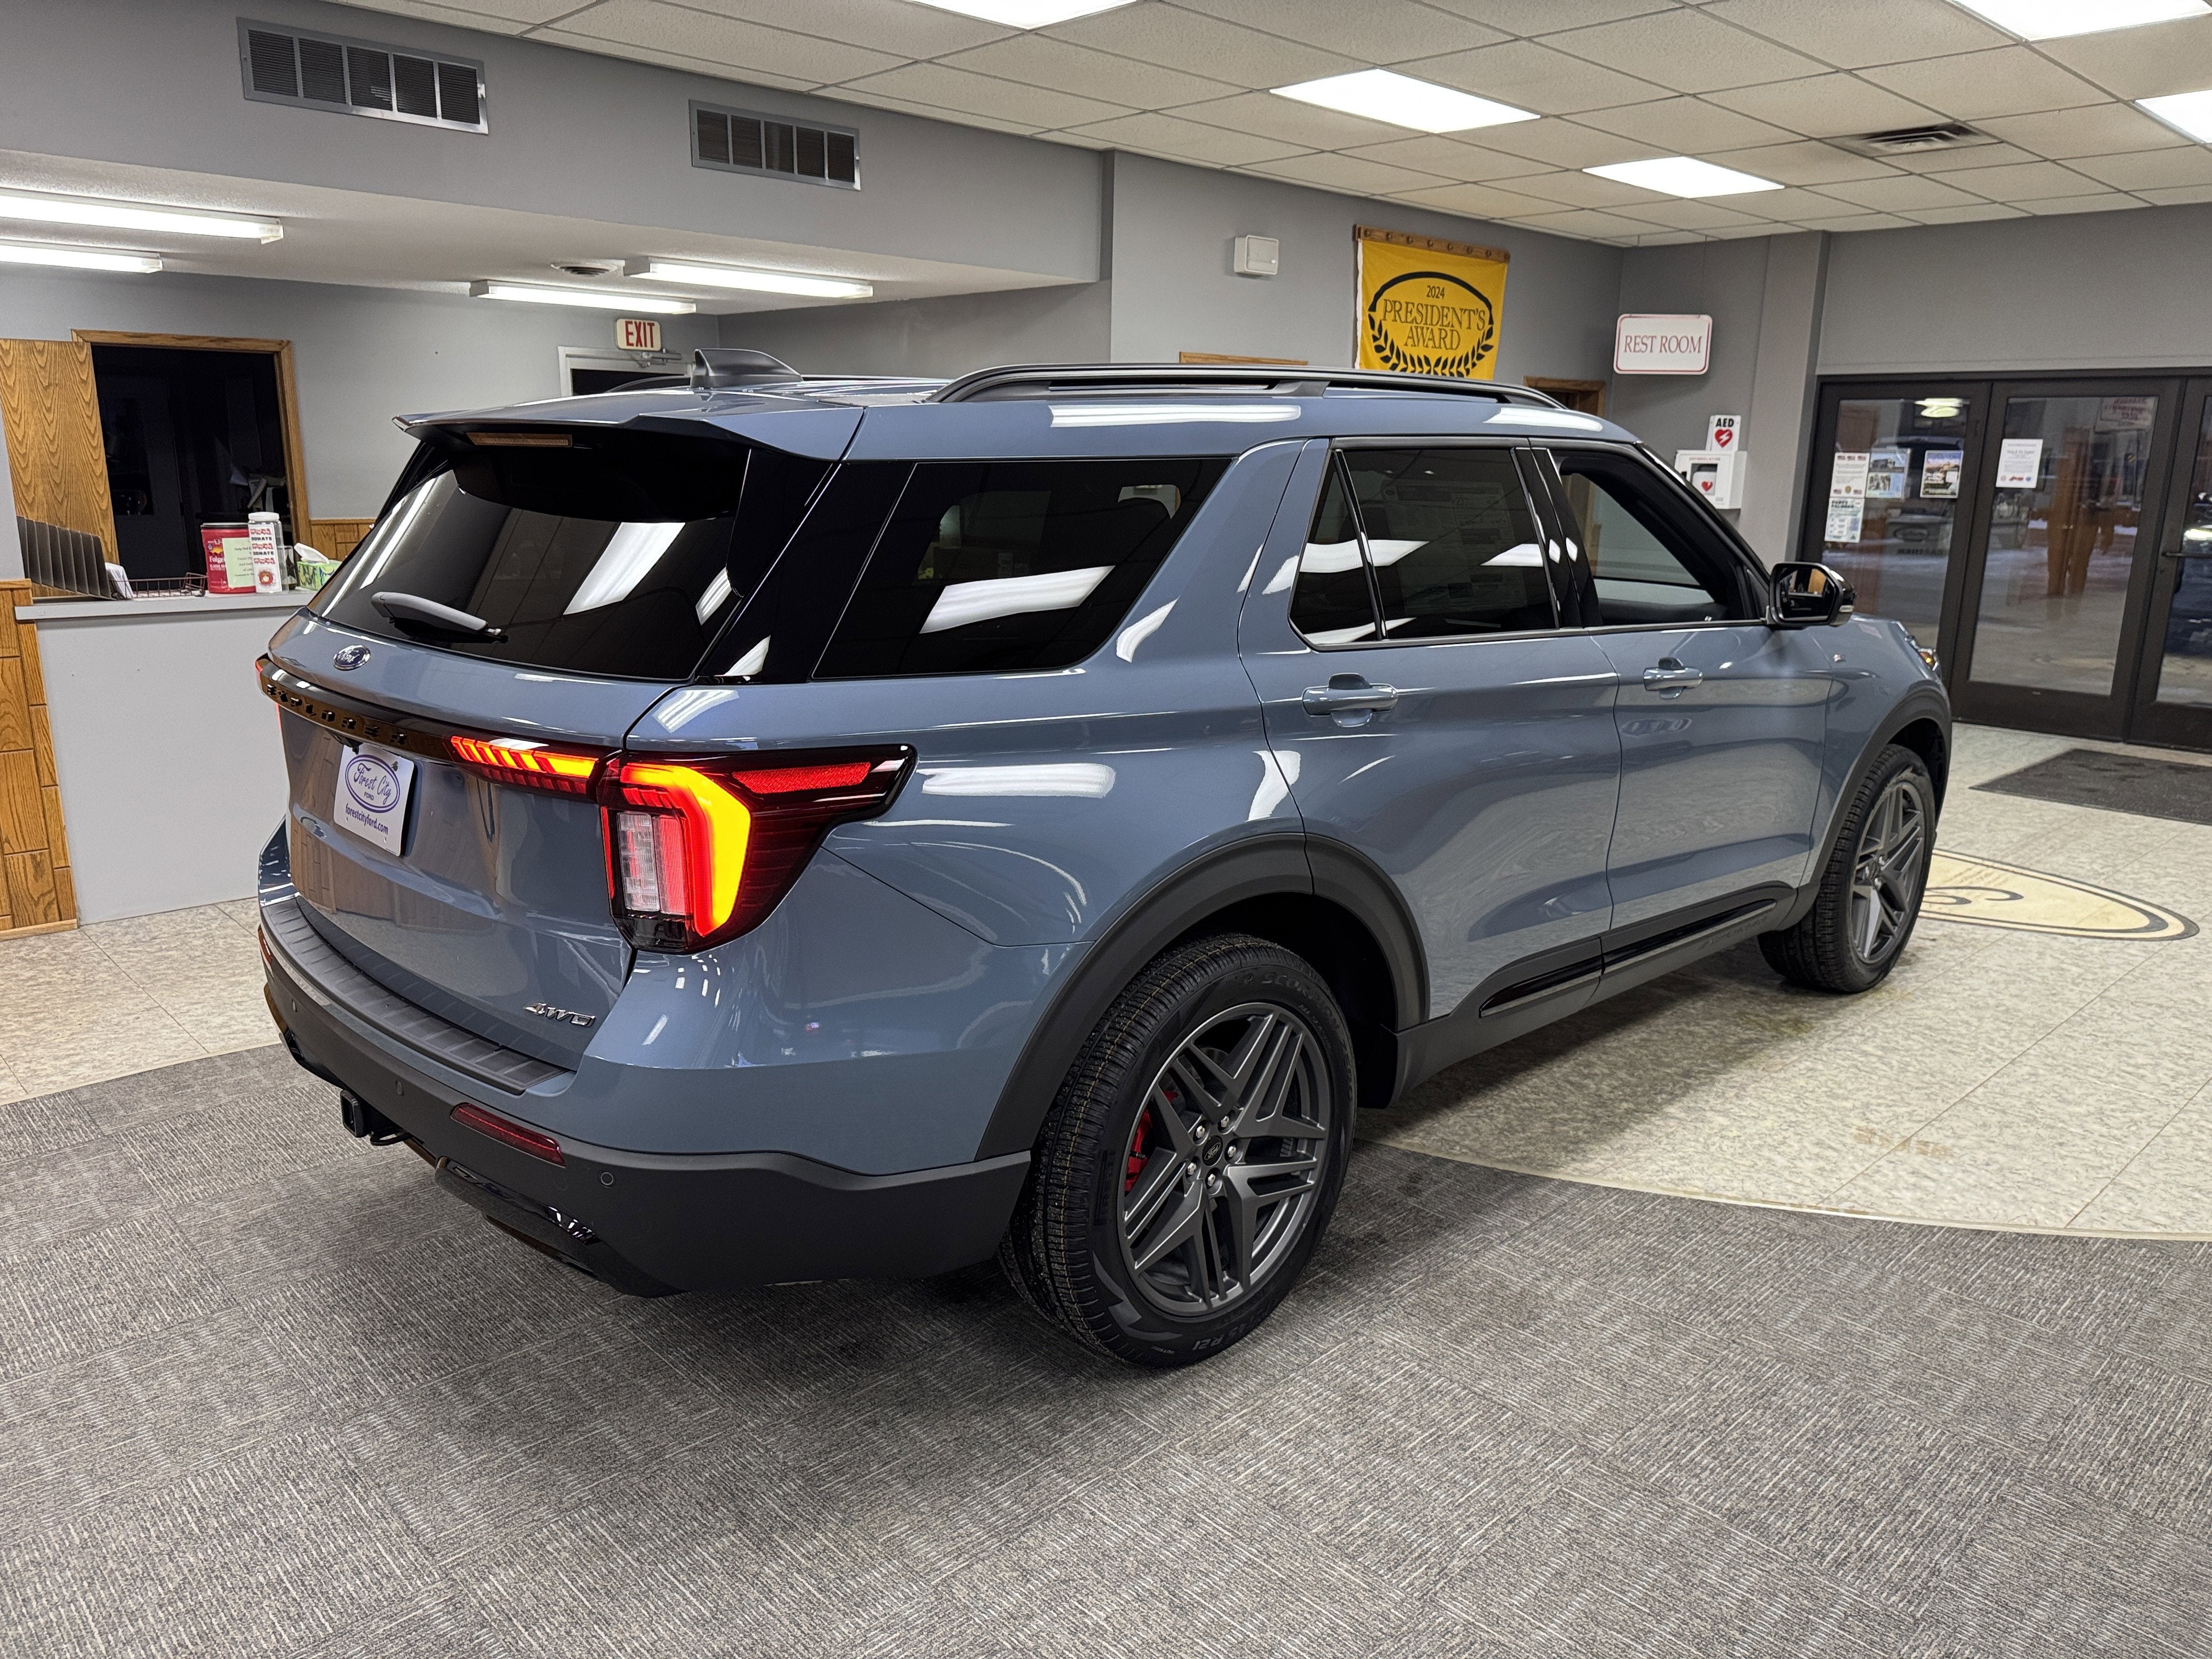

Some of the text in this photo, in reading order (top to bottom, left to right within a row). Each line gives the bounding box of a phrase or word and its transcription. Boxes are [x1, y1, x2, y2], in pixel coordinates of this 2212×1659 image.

[1426, 285, 1445, 299] 2024
[1381, 298, 1486, 331] PRESIDENT'S
[624, 320, 655, 348] EXIT
[1403, 325, 1460, 350] AWARD
[1623, 335, 1702, 354] REST ROOM
[1715, 417, 1735, 427] AED
[266, 683, 408, 746] EXPLORER
[353, 763, 392, 805] Forest City
[364, 791, 375, 801] FORD
[345, 803, 389, 835] forestcityford.com
[522, 1002, 597, 1028] 4WD
